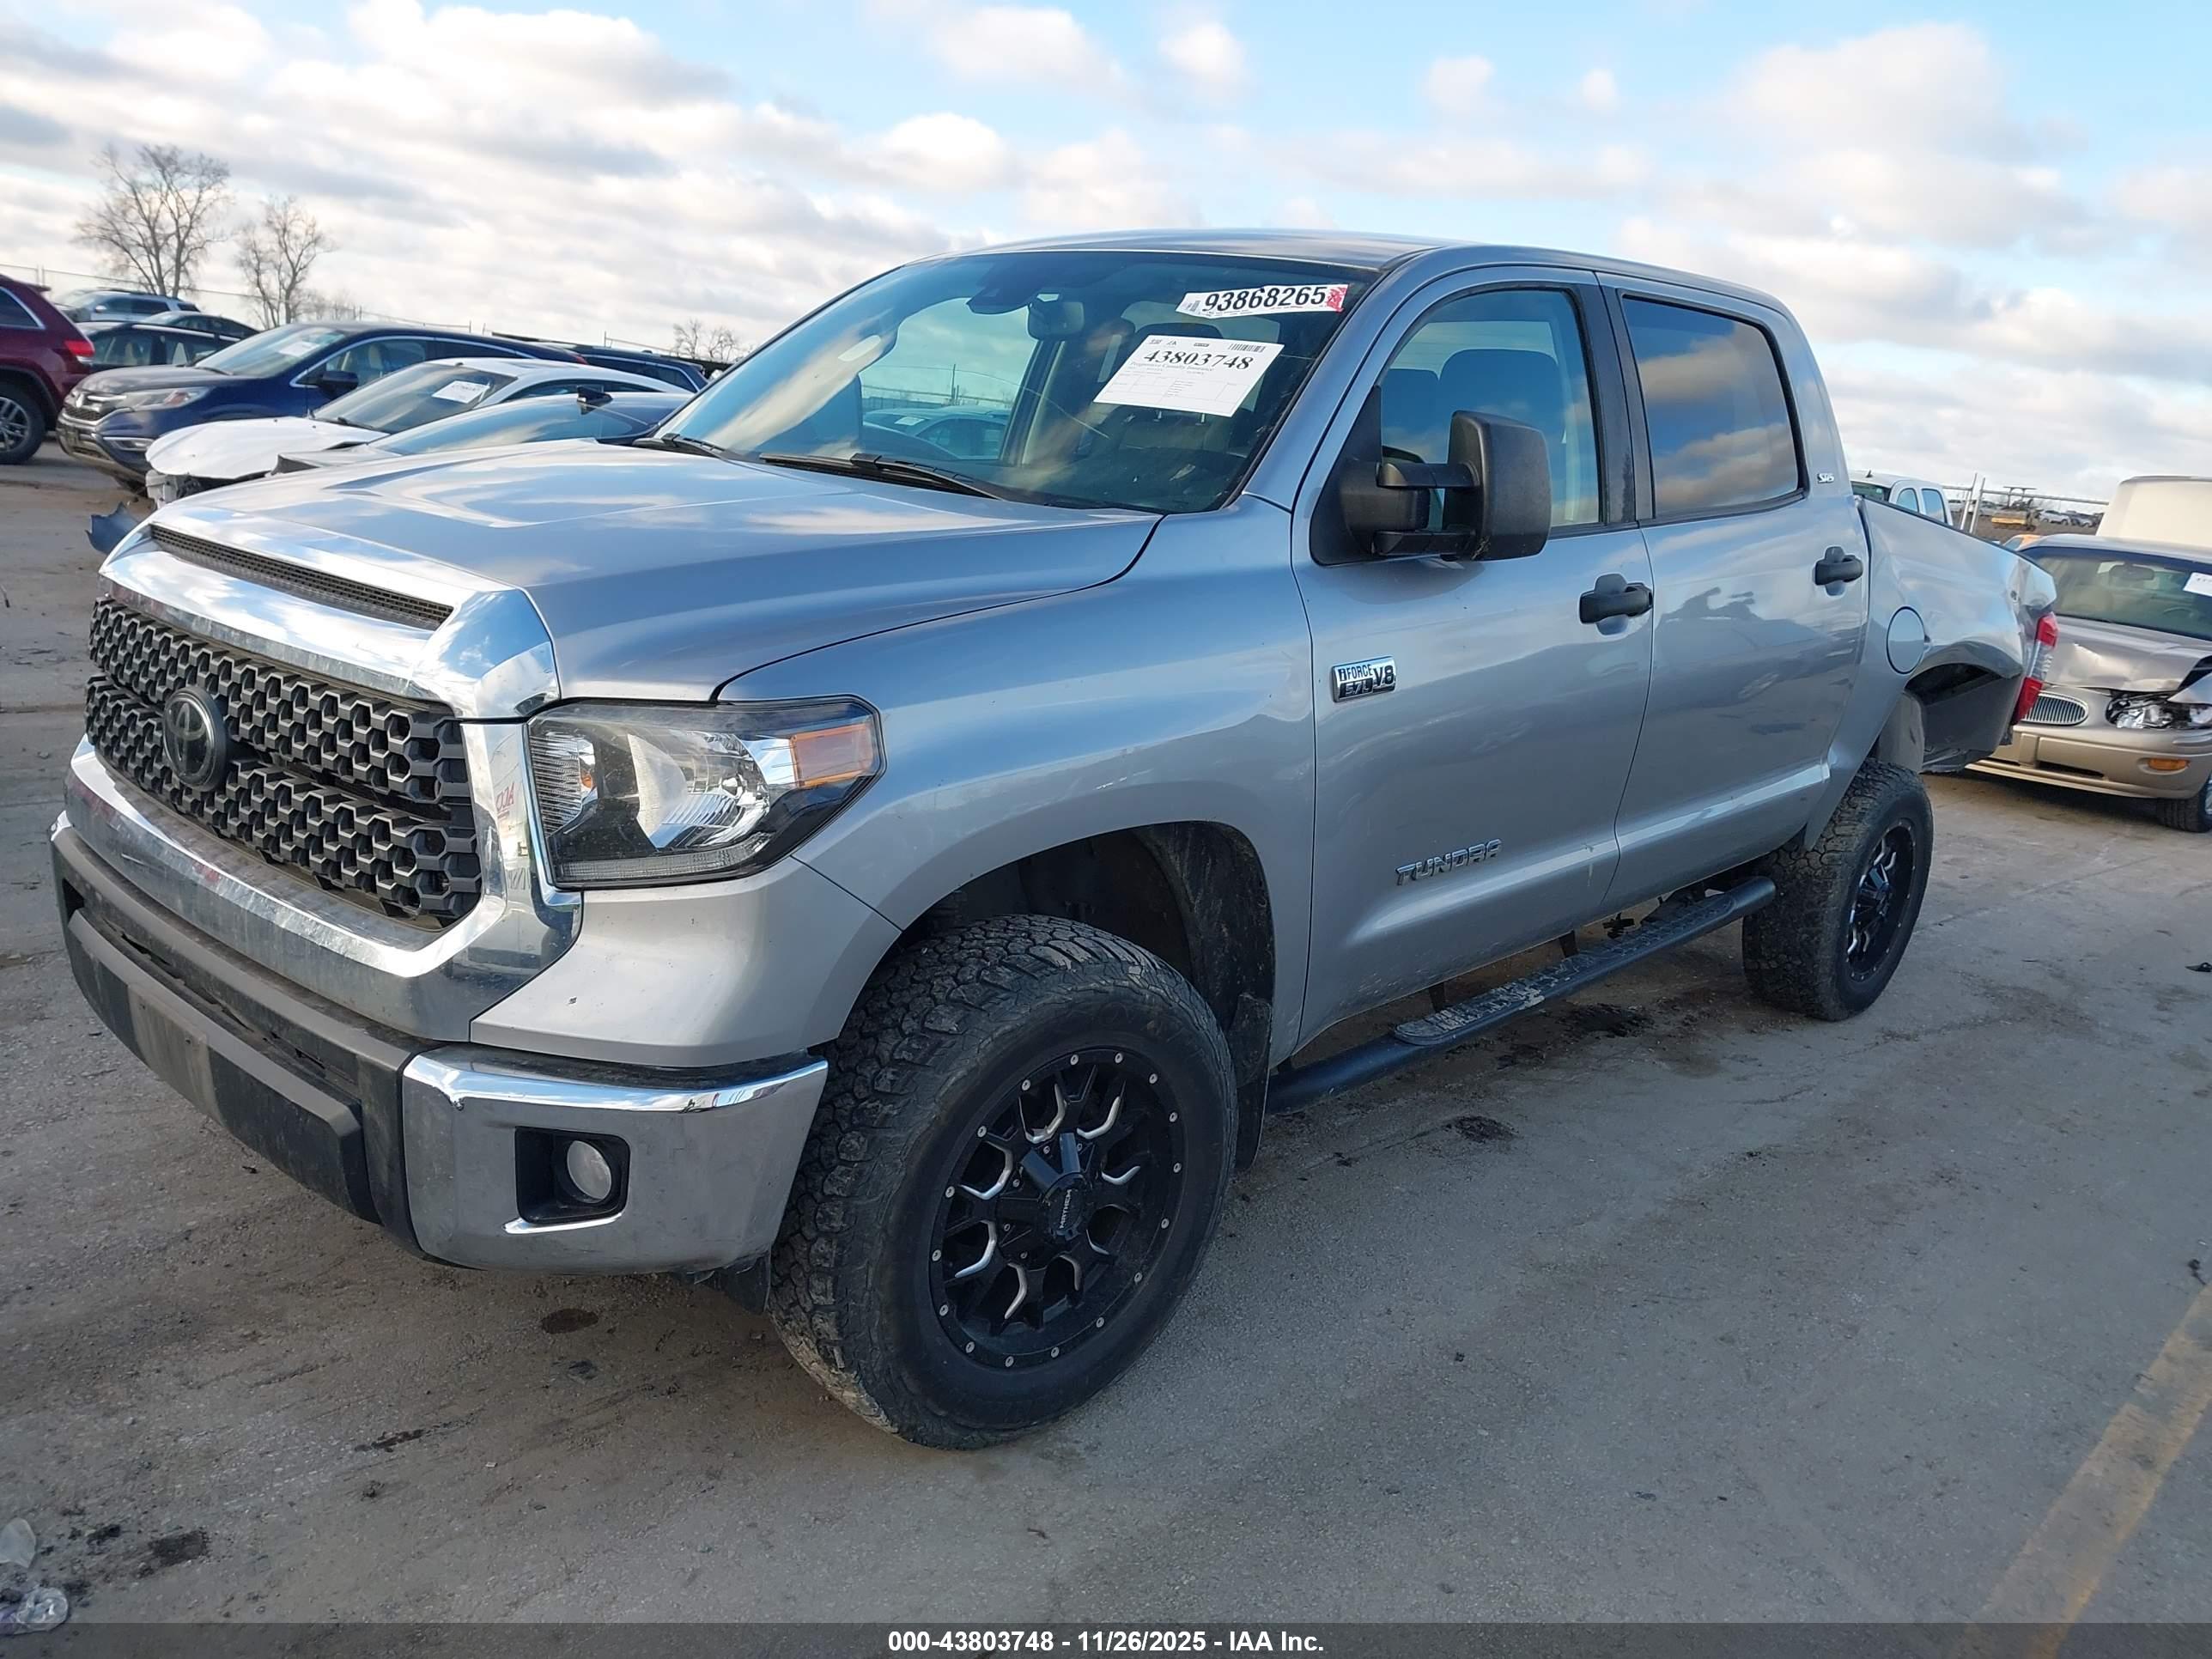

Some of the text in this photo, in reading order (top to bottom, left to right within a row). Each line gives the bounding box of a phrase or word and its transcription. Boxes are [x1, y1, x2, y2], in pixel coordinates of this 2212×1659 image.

[1202, 287, 1328, 312] 93868265
[1144, 349, 1254, 370] 43803748
[1373, 665, 1395, 686] V8
[1395, 838, 1503, 885] TUNDRA
